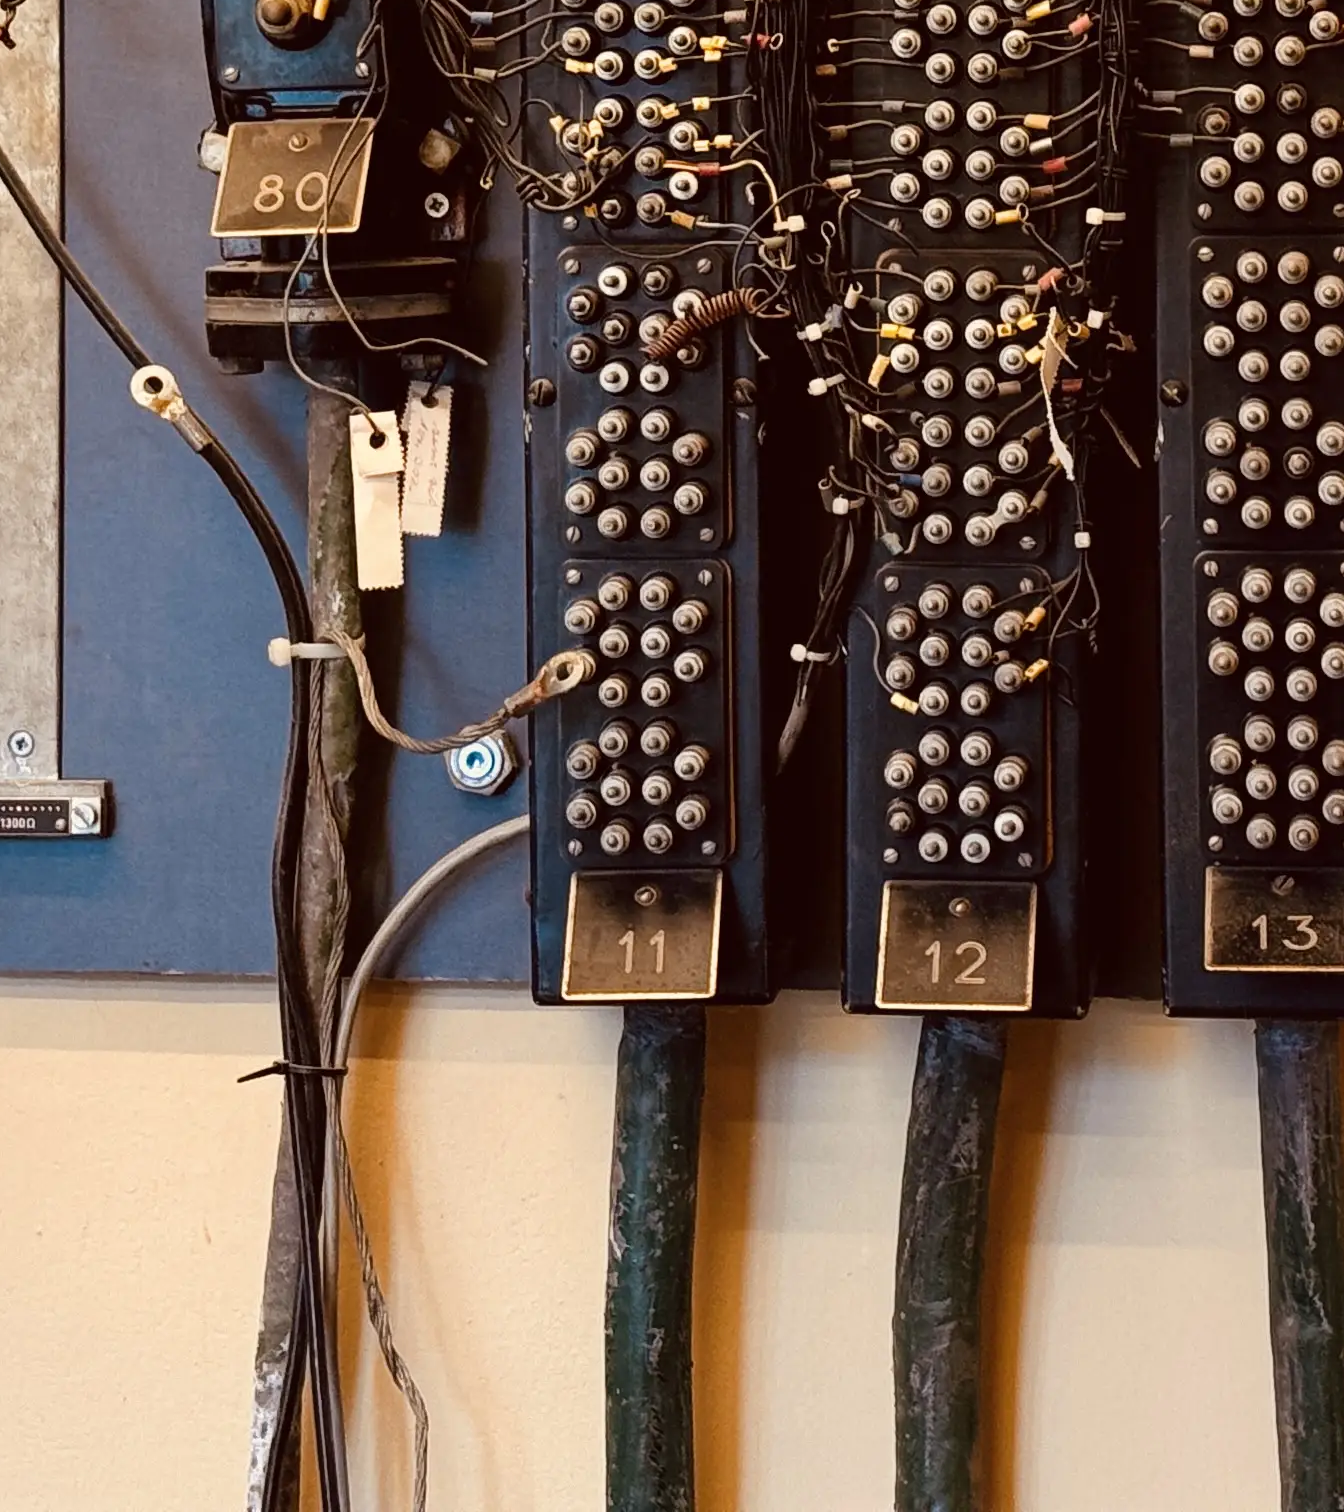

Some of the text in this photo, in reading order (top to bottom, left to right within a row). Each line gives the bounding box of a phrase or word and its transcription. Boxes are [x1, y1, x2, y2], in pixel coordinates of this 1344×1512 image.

[253, 172, 329, 213] 80
[618, 929, 667, 975] 11
[1251, 915, 1319, 950] 13
[925, 941, 987, 985] 12
